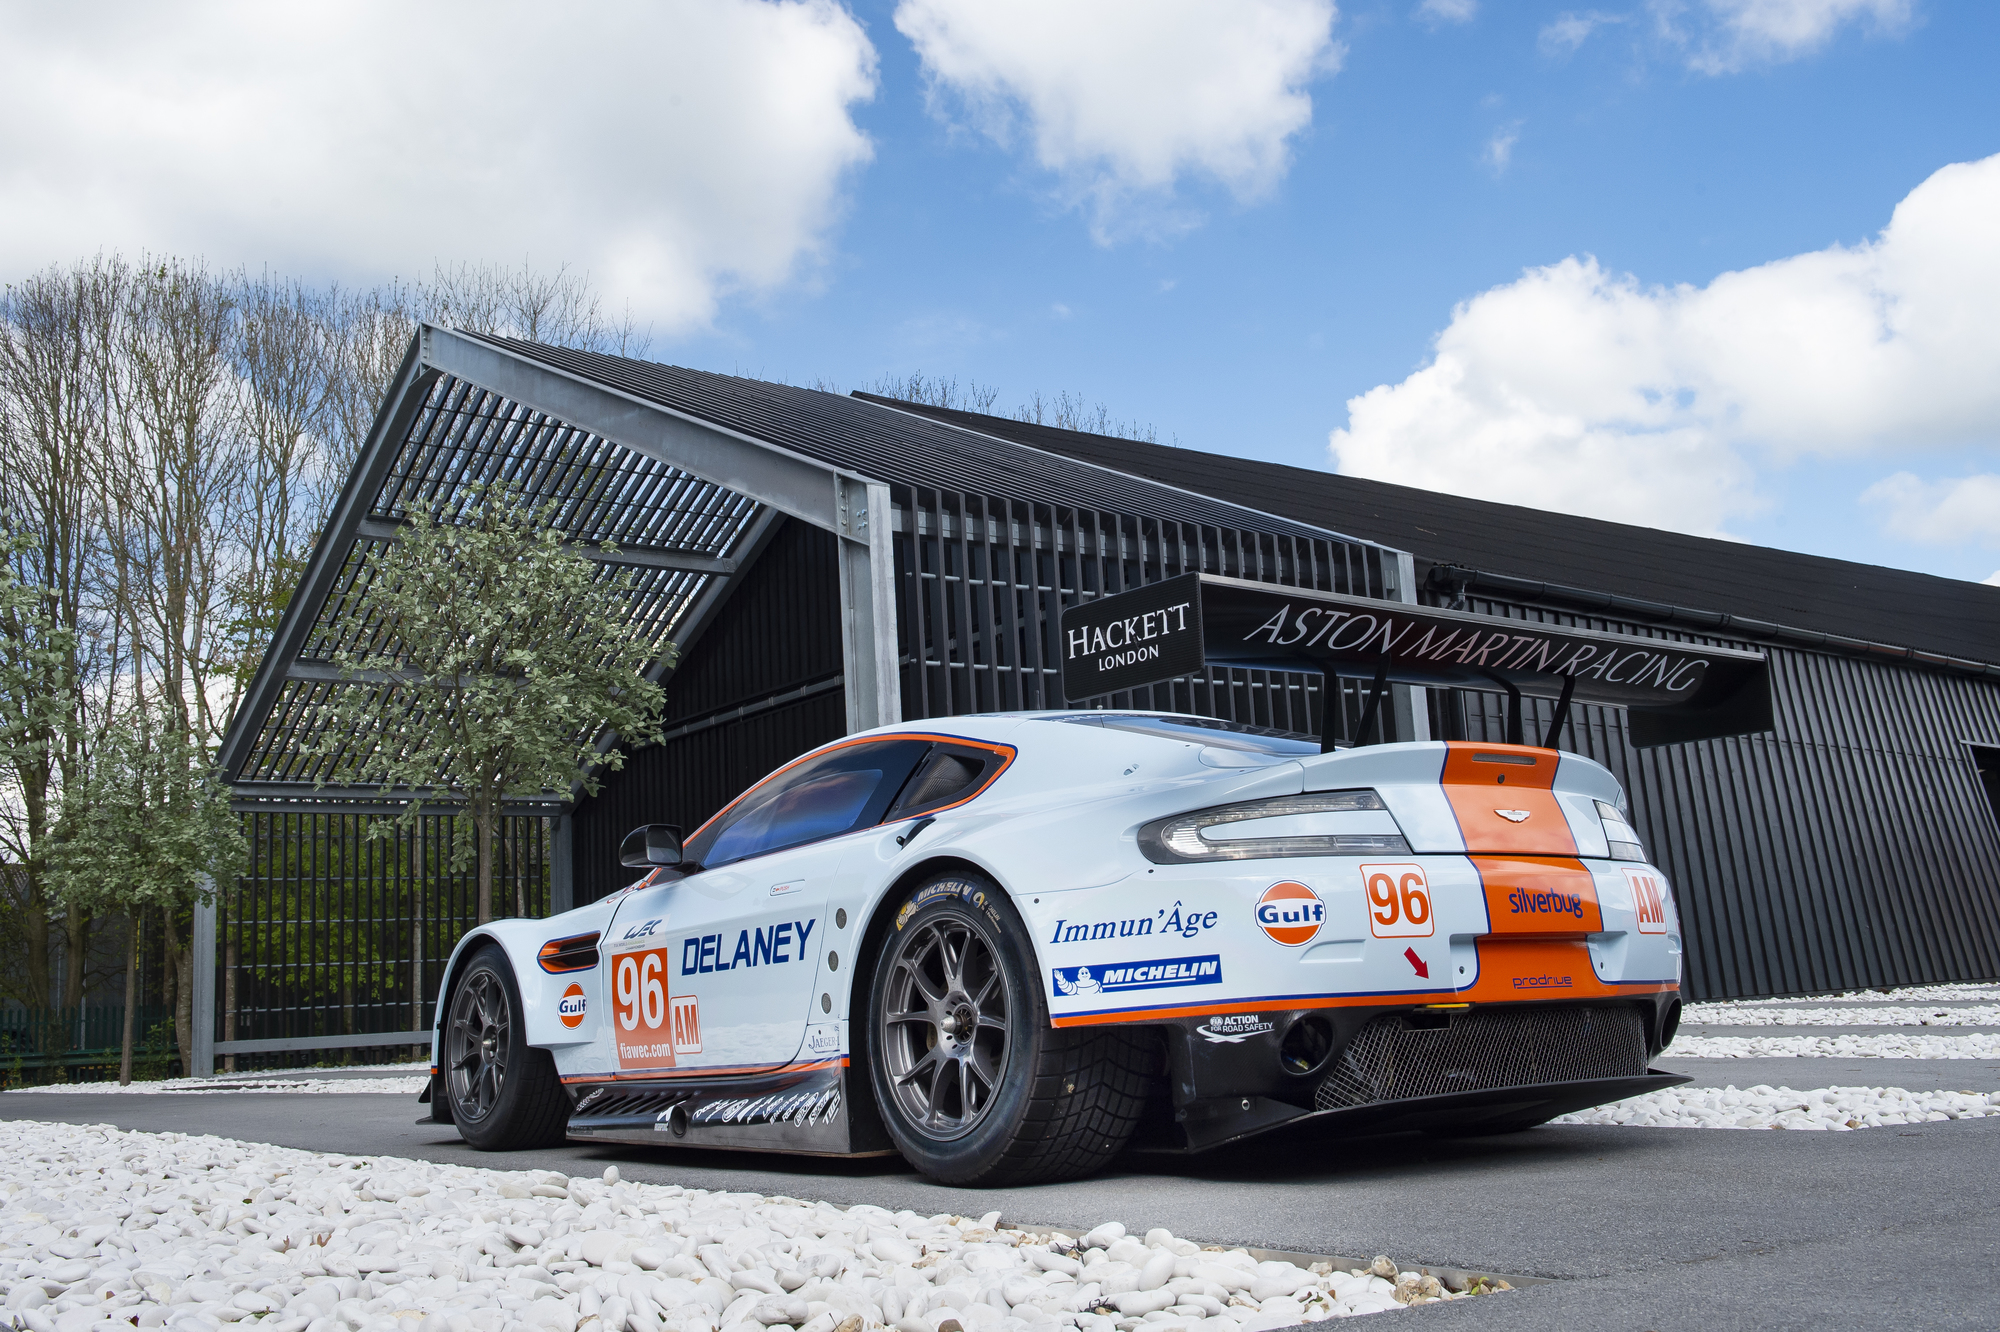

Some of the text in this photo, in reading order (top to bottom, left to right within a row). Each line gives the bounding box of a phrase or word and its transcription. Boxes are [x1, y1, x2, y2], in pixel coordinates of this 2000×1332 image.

[1068, 602, 1190, 659] HACKETT
[1098, 644, 1160, 672] LONDON
[1243, 603, 1709, 692] ASTON MARTIN RACING
[918, 881, 972, 902] MICHELIN
[1368, 872, 1430, 926] 96
[1508, 887, 1583, 918] silverbug
[1632, 876, 1664, 923] AM
[1257, 904, 1323, 924] Gulf
[623, 919, 663, 939] WEC
[681, 918, 816, 976] DELANEY
[1102, 961, 1218, 983] MICHELIN
[1512, 974, 1572, 989] prodrive
[617, 953, 664, 1031] 96
[559, 998, 587, 1013] Gulf
[675, 1004, 699, 1046] AM
[1223, 1024, 1244, 1032] ROAD
[1244, 1022, 1273, 1032] SAFETY
[1224, 1015, 1259, 1025] ACTION
[620, 1041, 671, 1059] fiawec.com
